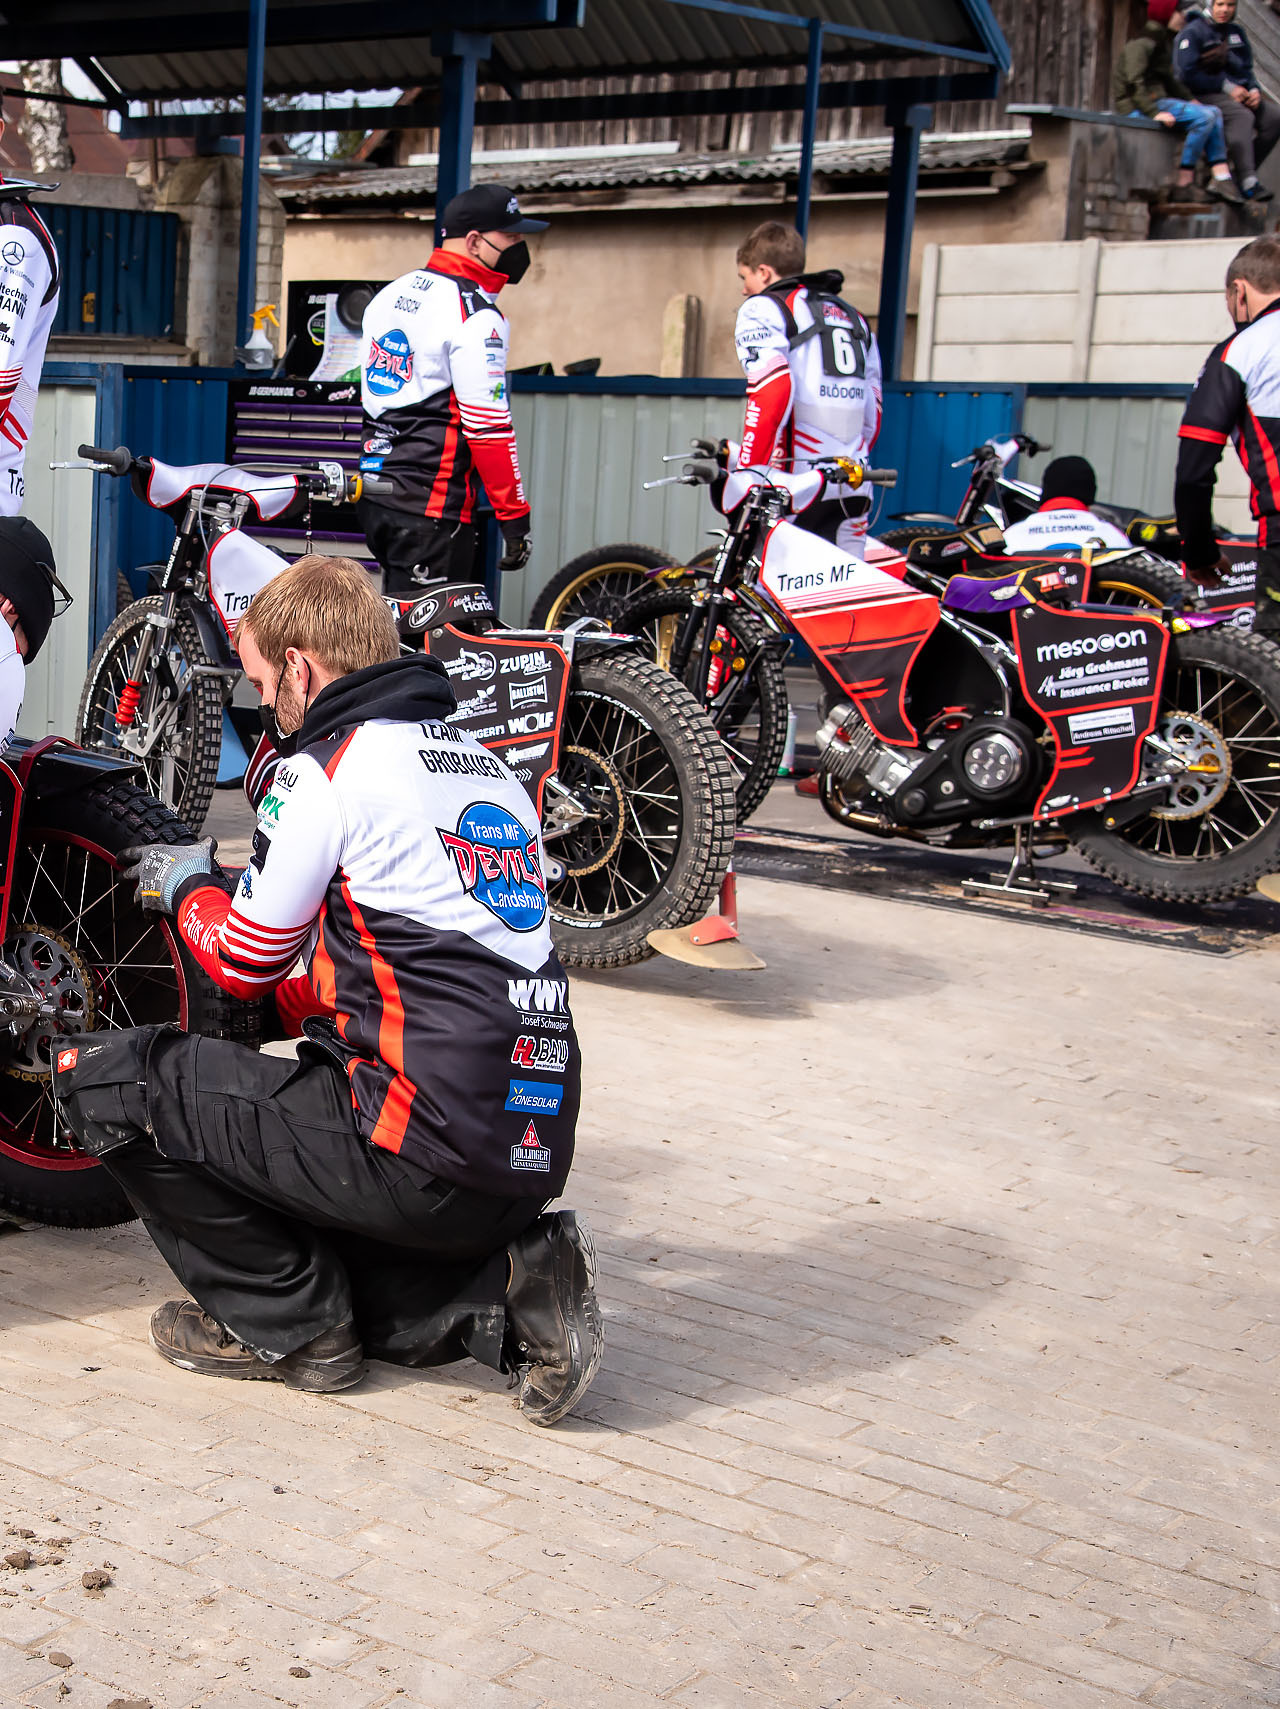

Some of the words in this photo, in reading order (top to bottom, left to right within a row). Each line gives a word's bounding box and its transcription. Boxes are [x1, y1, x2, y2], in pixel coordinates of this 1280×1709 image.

[366, 337, 414, 383] DEVILS
[832, 327, 857, 375] 6
[778, 572, 824, 592] Trans
[830, 563, 857, 582] MF
[1036, 629, 1148, 662] mesocon
[500, 651, 545, 674] ZUPIN
[1085, 656, 1148, 675] Grohmann
[512, 684, 545, 700] BALLISTOL
[1060, 682, 1111, 699] Insurance
[1111, 676, 1150, 691] Broker
[507, 712, 554, 734] WOLF
[419, 749, 507, 781] GROBAUER
[467, 820, 503, 840] Trans
[503, 823, 520, 841] MF
[435, 826, 546, 896] DEVILS
[487, 888, 544, 911] Landshut
[521, 1014, 541, 1028] Josef
[540, 1016, 569, 1033] Schwaiger
[538, 1038, 570, 1066] BAU
[515, 1094, 559, 1109] ONESOLAR
